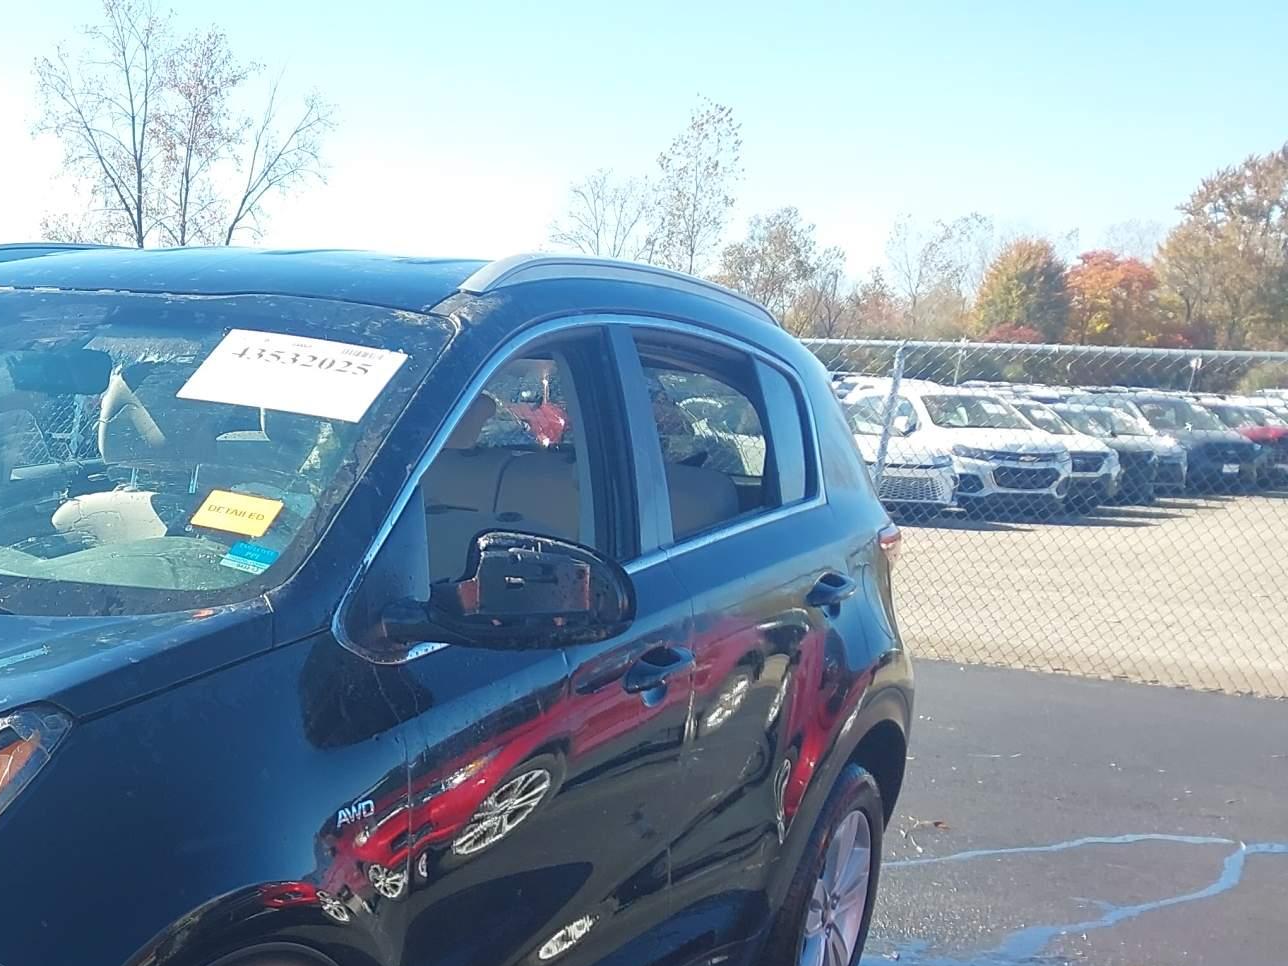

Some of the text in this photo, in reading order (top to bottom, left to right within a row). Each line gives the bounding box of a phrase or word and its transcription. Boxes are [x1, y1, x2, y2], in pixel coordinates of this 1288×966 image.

[231, 346, 374, 376] 43532025
[207, 504, 266, 521] DETAILED
[336, 799, 376, 828] AWD
